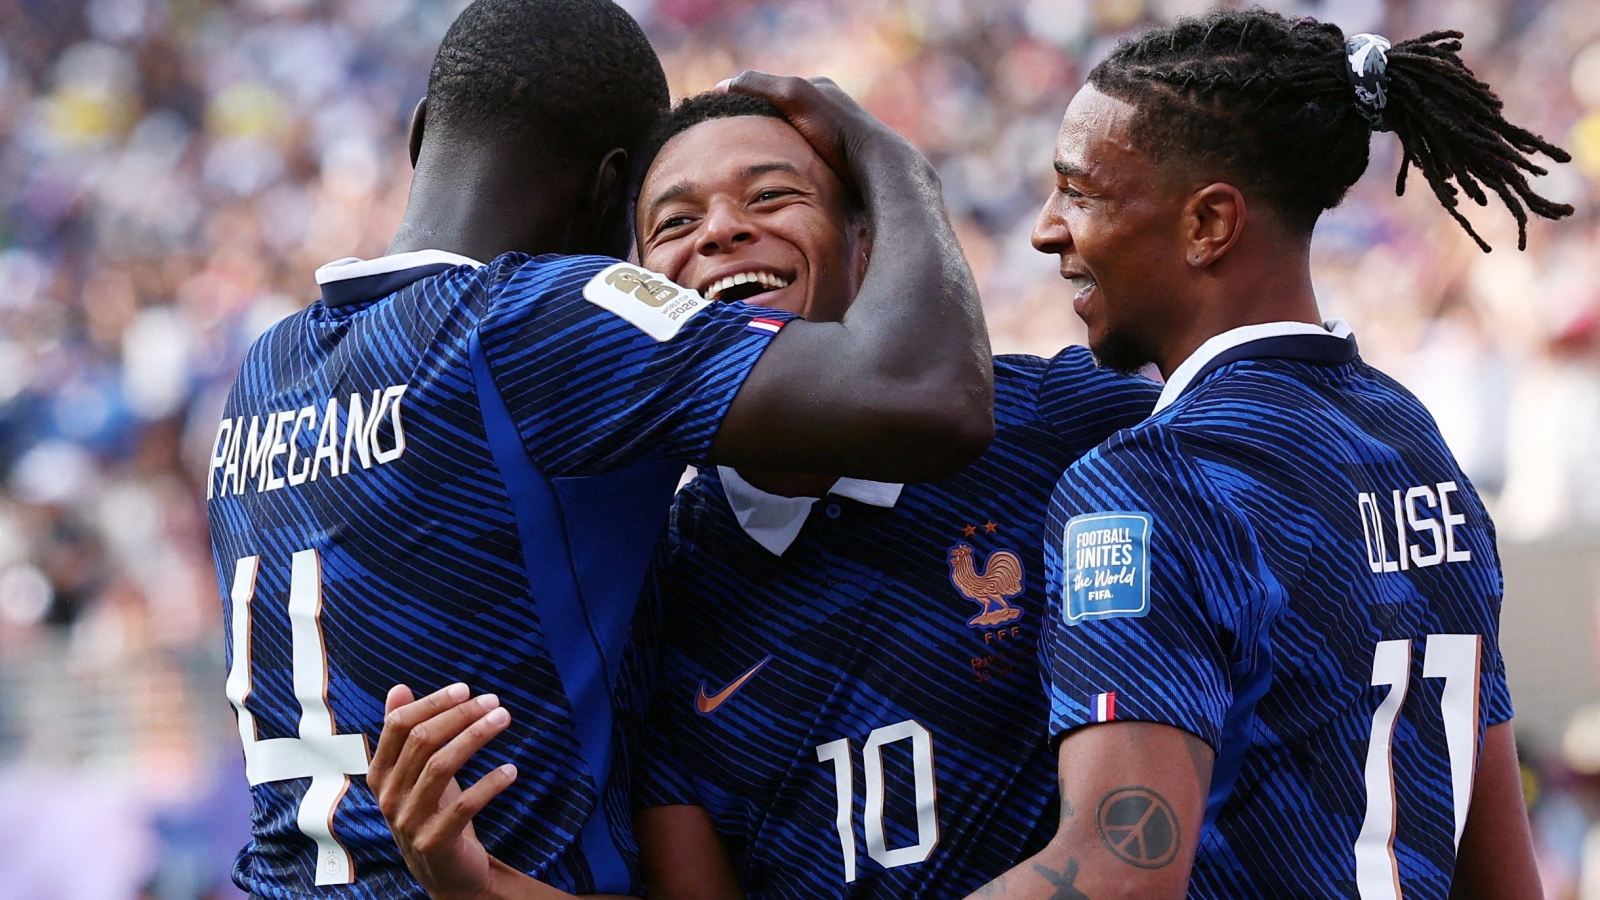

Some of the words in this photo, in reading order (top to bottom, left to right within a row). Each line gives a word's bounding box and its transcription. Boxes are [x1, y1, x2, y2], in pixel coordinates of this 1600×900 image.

[661, 300, 680, 315] WORLD
[669, 299, 698, 320] 2026
[207, 384, 408, 501] PAMECANO
[1076, 527, 1132, 549] FOOTBALL
[1076, 543, 1132, 570] UNITES
[1358, 481, 1471, 573] OLISE
[1073, 571, 1092, 592] the
[1095, 566, 1136, 588] World
[226, 548, 371, 886] 4
[1354, 633, 1482, 900] 11
[816, 719, 940, 883] 10
